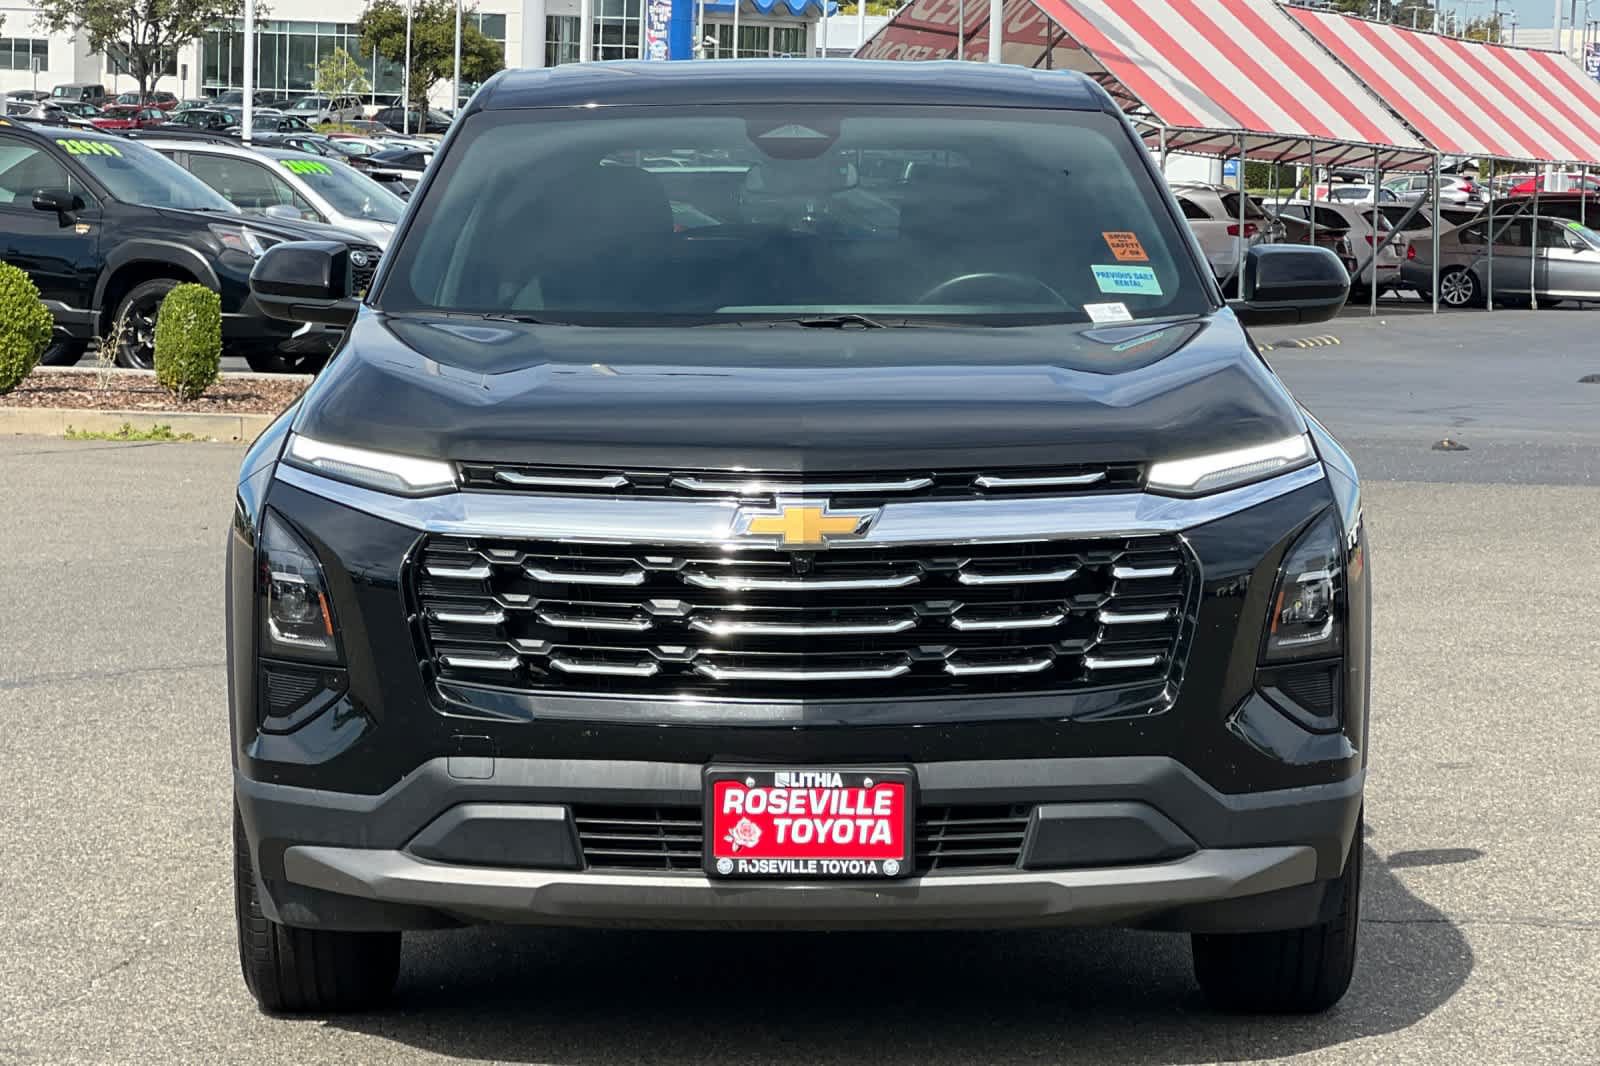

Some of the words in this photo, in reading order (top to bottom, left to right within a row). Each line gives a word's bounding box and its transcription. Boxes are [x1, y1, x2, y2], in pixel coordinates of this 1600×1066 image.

[1095, 271, 1133, 280] PREVIOUS
[1113, 279, 1145, 288] RENTAL
[790, 773, 843, 788] LITHIA
[723, 788, 894, 816] ROSEVILLE
[773, 818, 892, 845] TOYOTA
[738, 859, 817, 874] ROSEVILLE
[820, 859, 877, 875] TOYOTA
